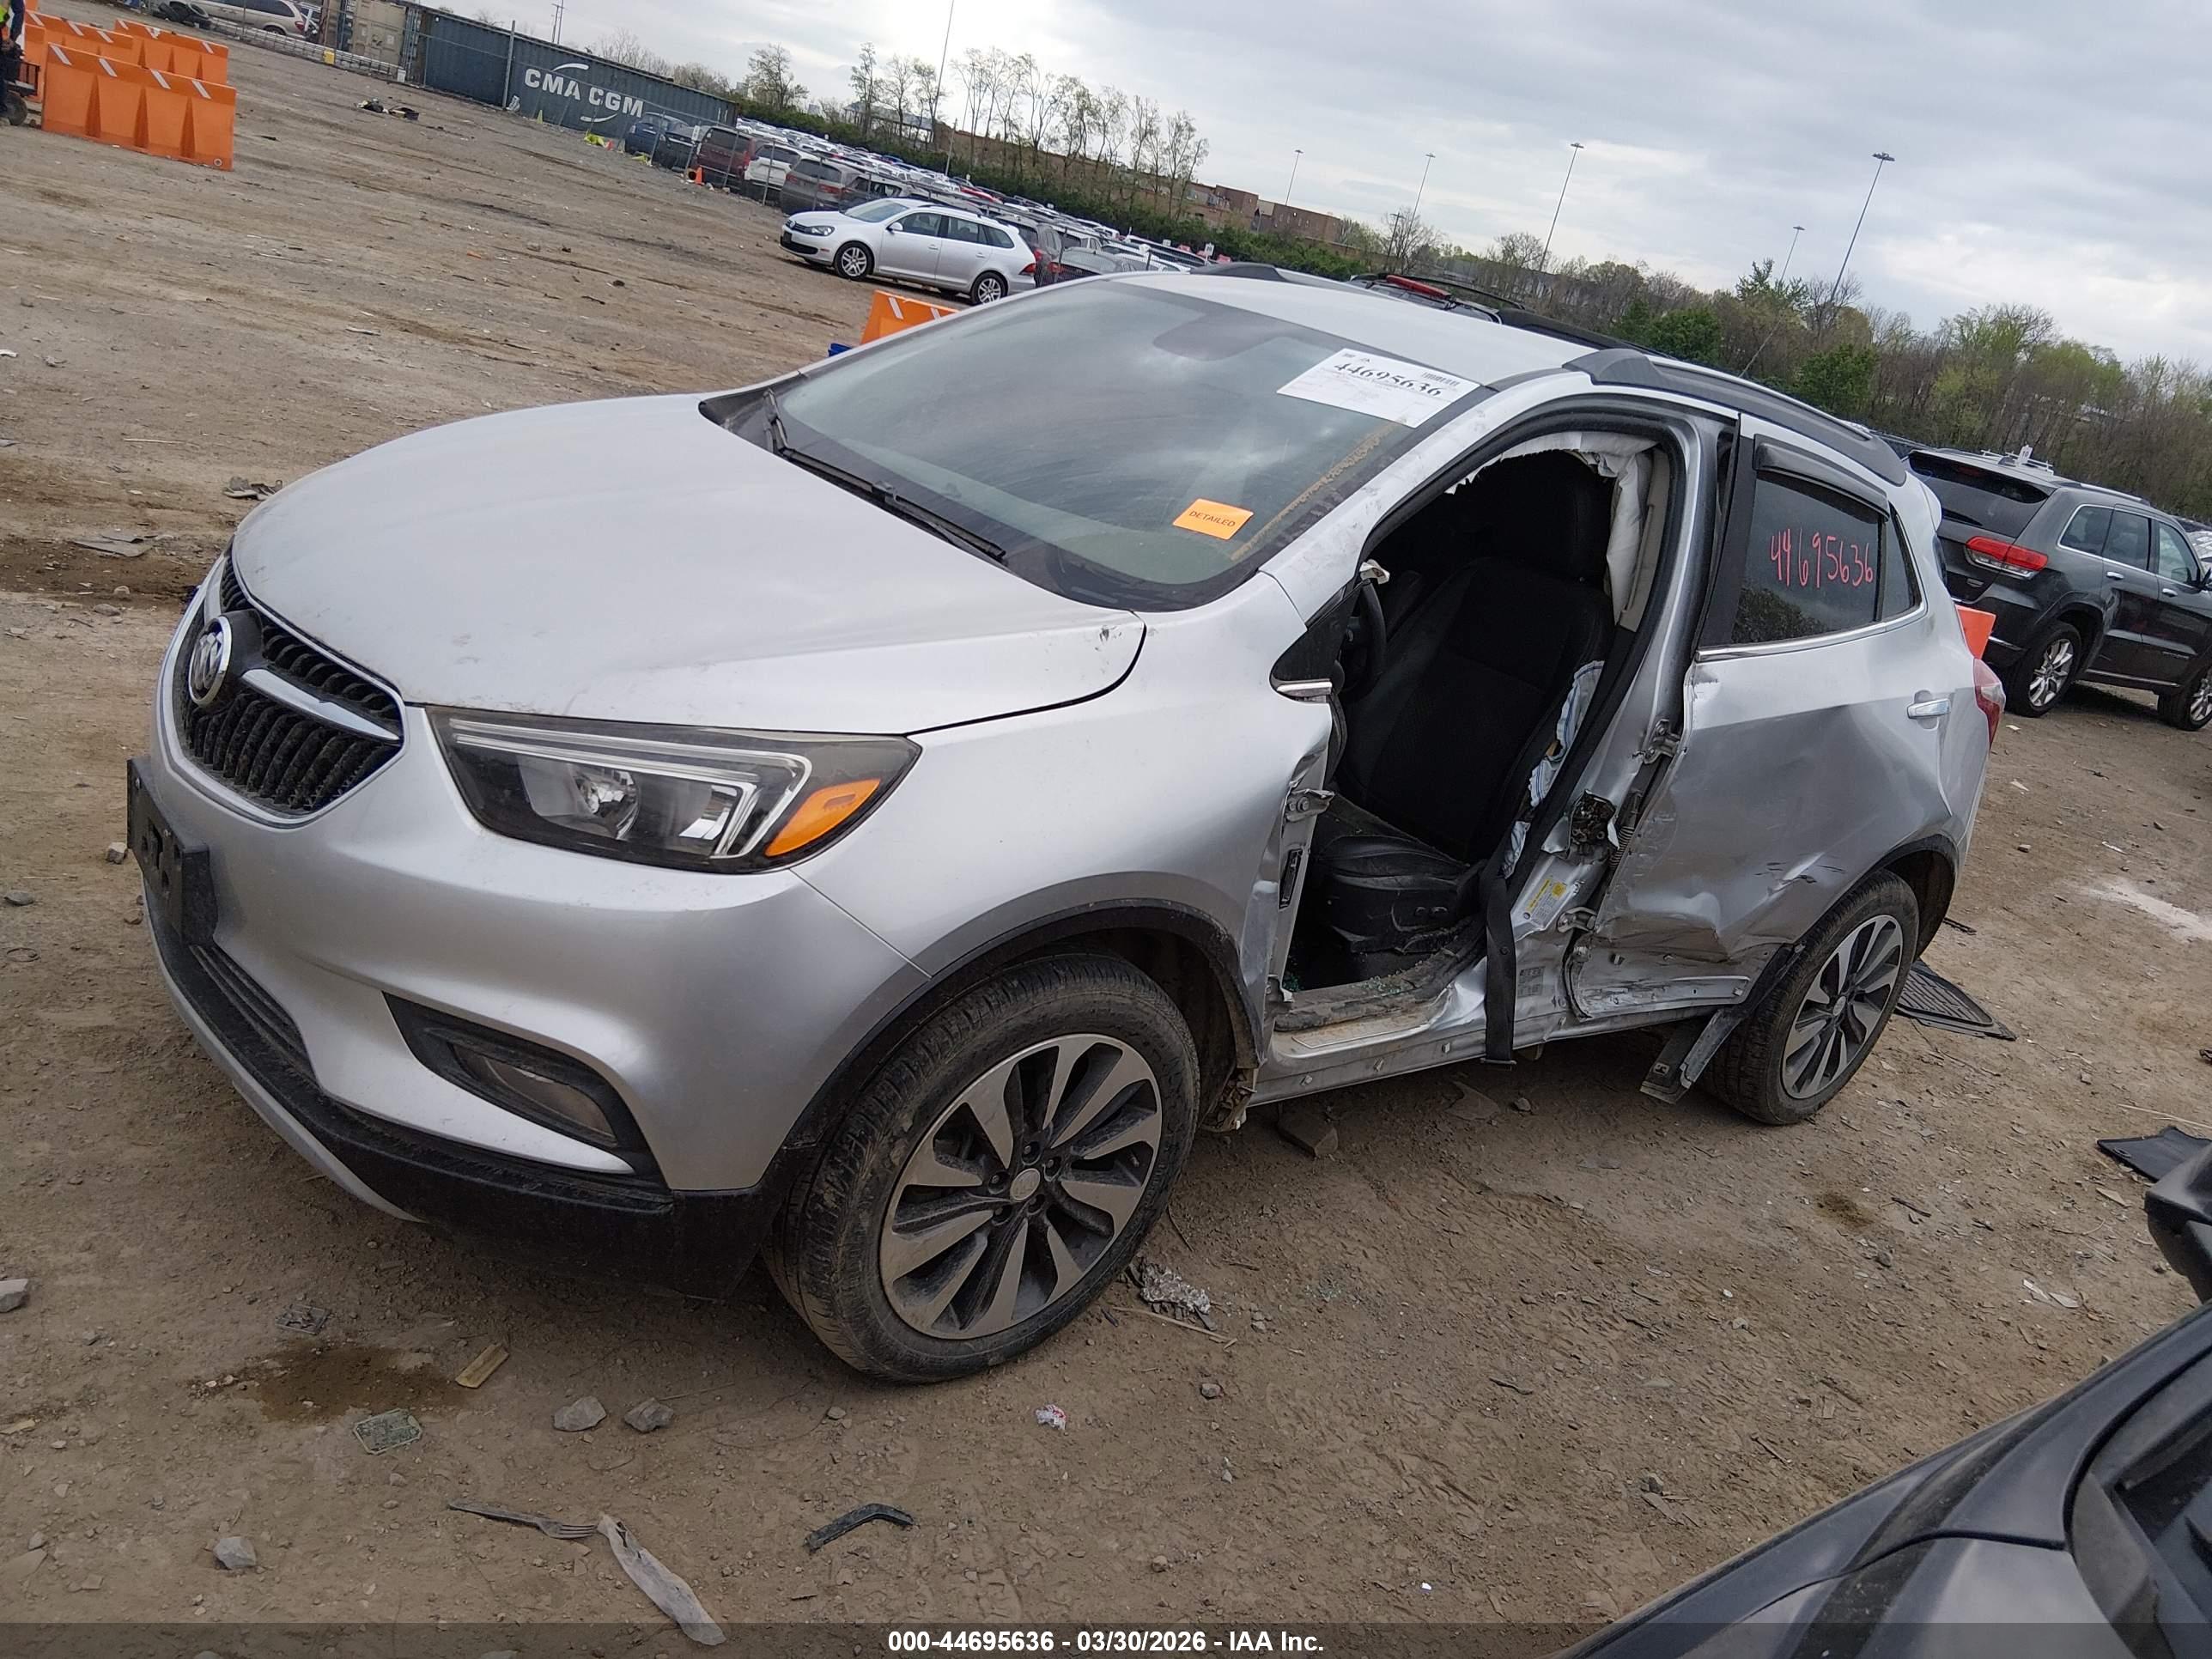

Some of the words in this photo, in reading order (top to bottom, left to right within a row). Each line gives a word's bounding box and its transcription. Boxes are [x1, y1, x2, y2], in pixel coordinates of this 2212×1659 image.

[525, 68, 580, 100] CMA
[588, 87, 644, 118] CGM
[1334, 362, 1442, 397] 44695636
[1188, 510, 1237, 527] DETAILED
[1771, 528, 1873, 588] 44695636
